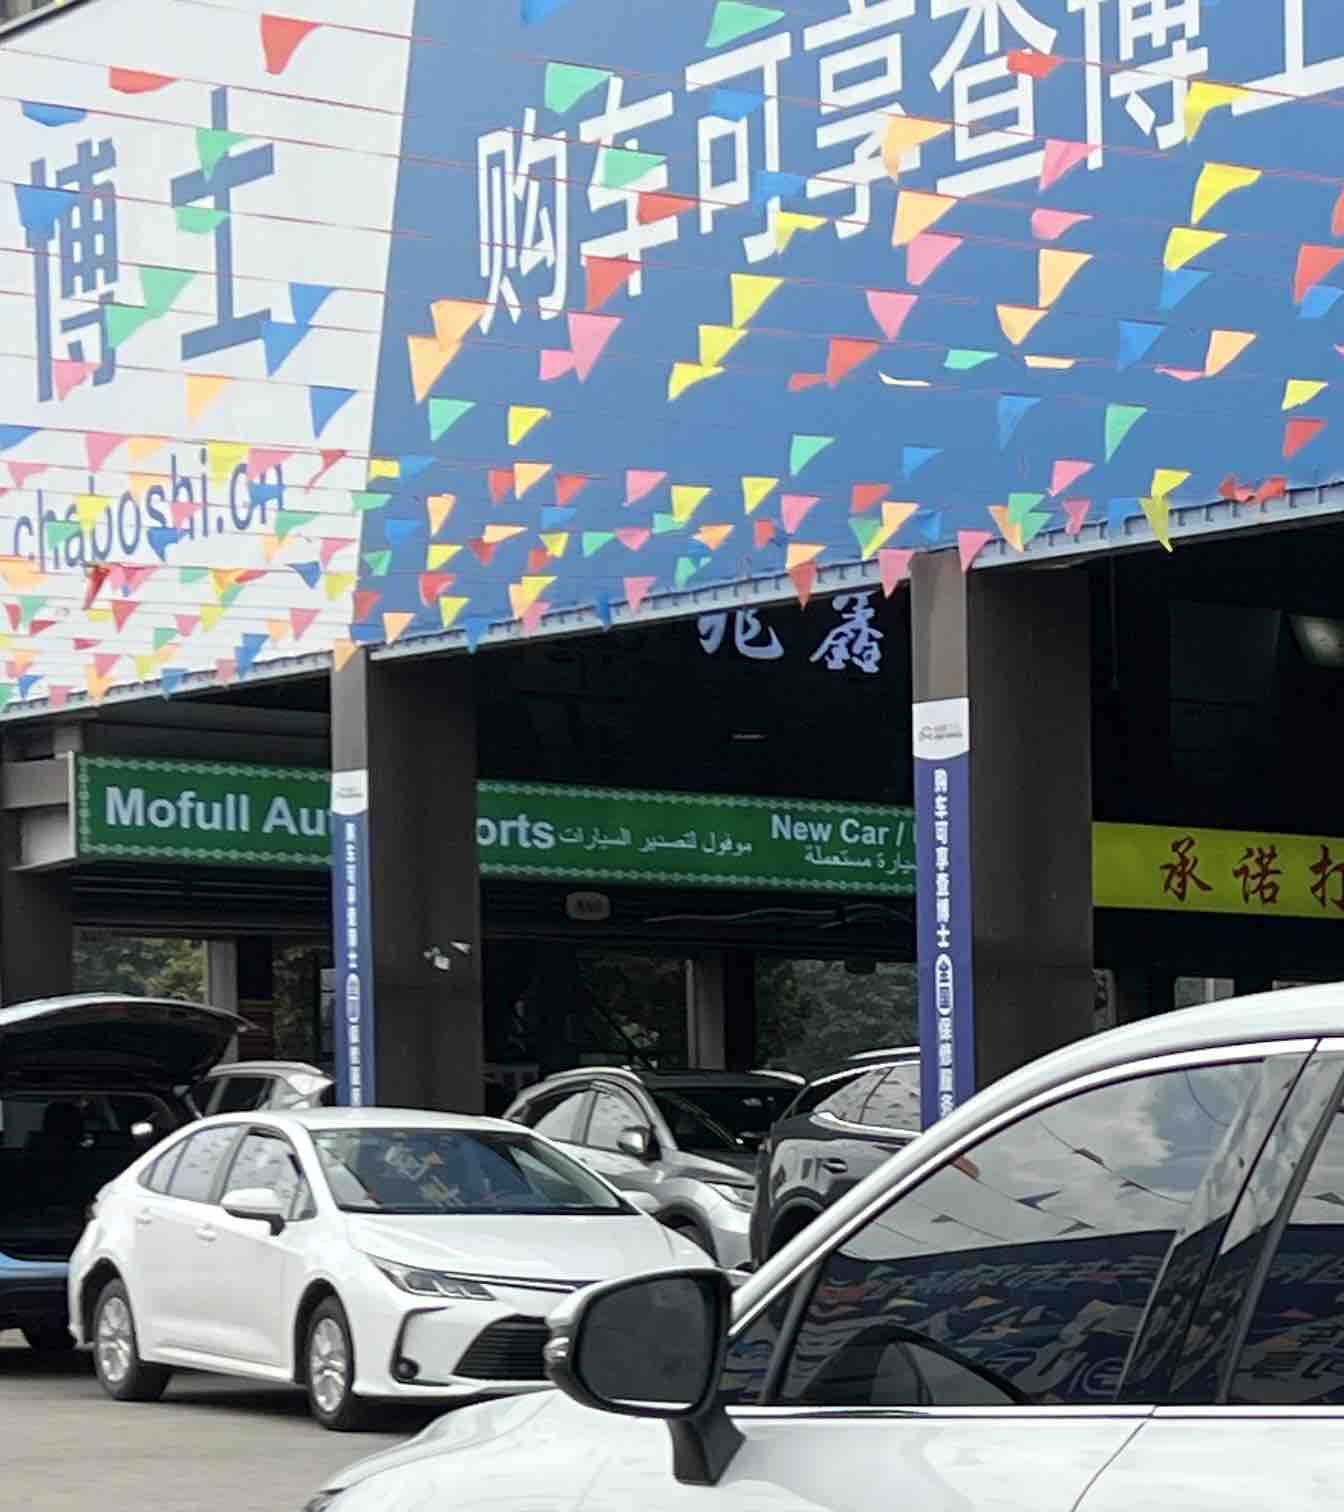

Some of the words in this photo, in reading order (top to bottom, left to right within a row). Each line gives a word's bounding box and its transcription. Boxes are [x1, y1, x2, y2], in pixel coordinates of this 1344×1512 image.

[105, 785, 249, 833] Mofull
[262, 797, 333, 837] Au
[477, 813, 556, 849] orts
[771, 813, 833, 842] New
[840, 817, 890, 846] Car
[877, 851, 917, 875] يارة
